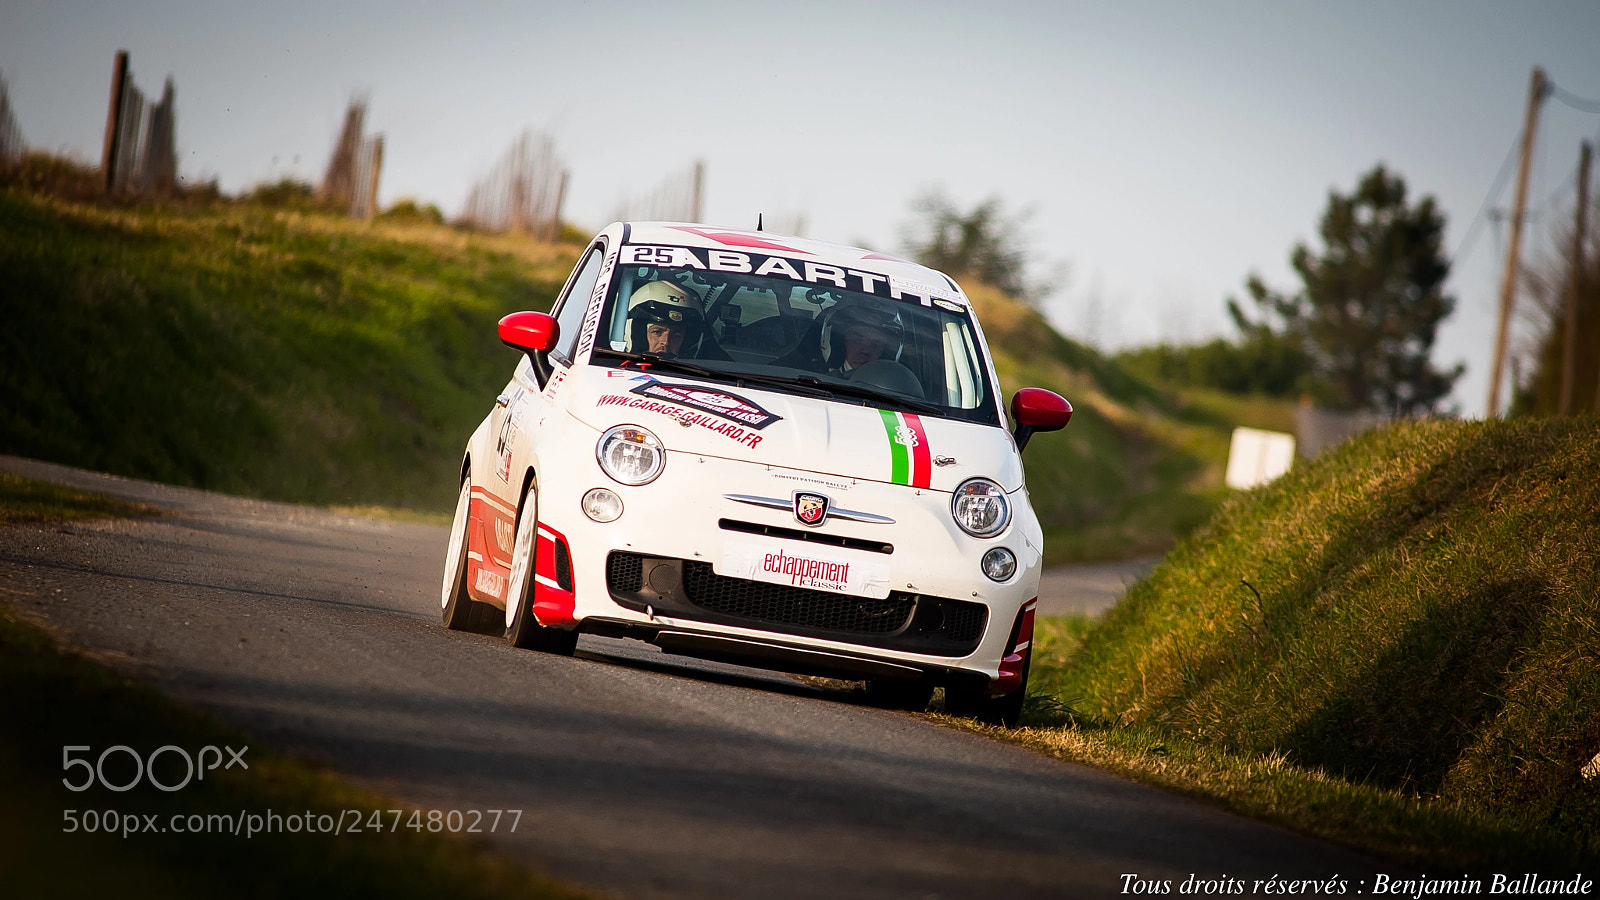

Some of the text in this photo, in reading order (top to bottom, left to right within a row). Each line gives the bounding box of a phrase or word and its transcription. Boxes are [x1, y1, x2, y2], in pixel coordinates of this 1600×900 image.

[633, 247, 674, 264] 25
[763, 548, 851, 586] echappement
[802, 577, 848, 592] classic
